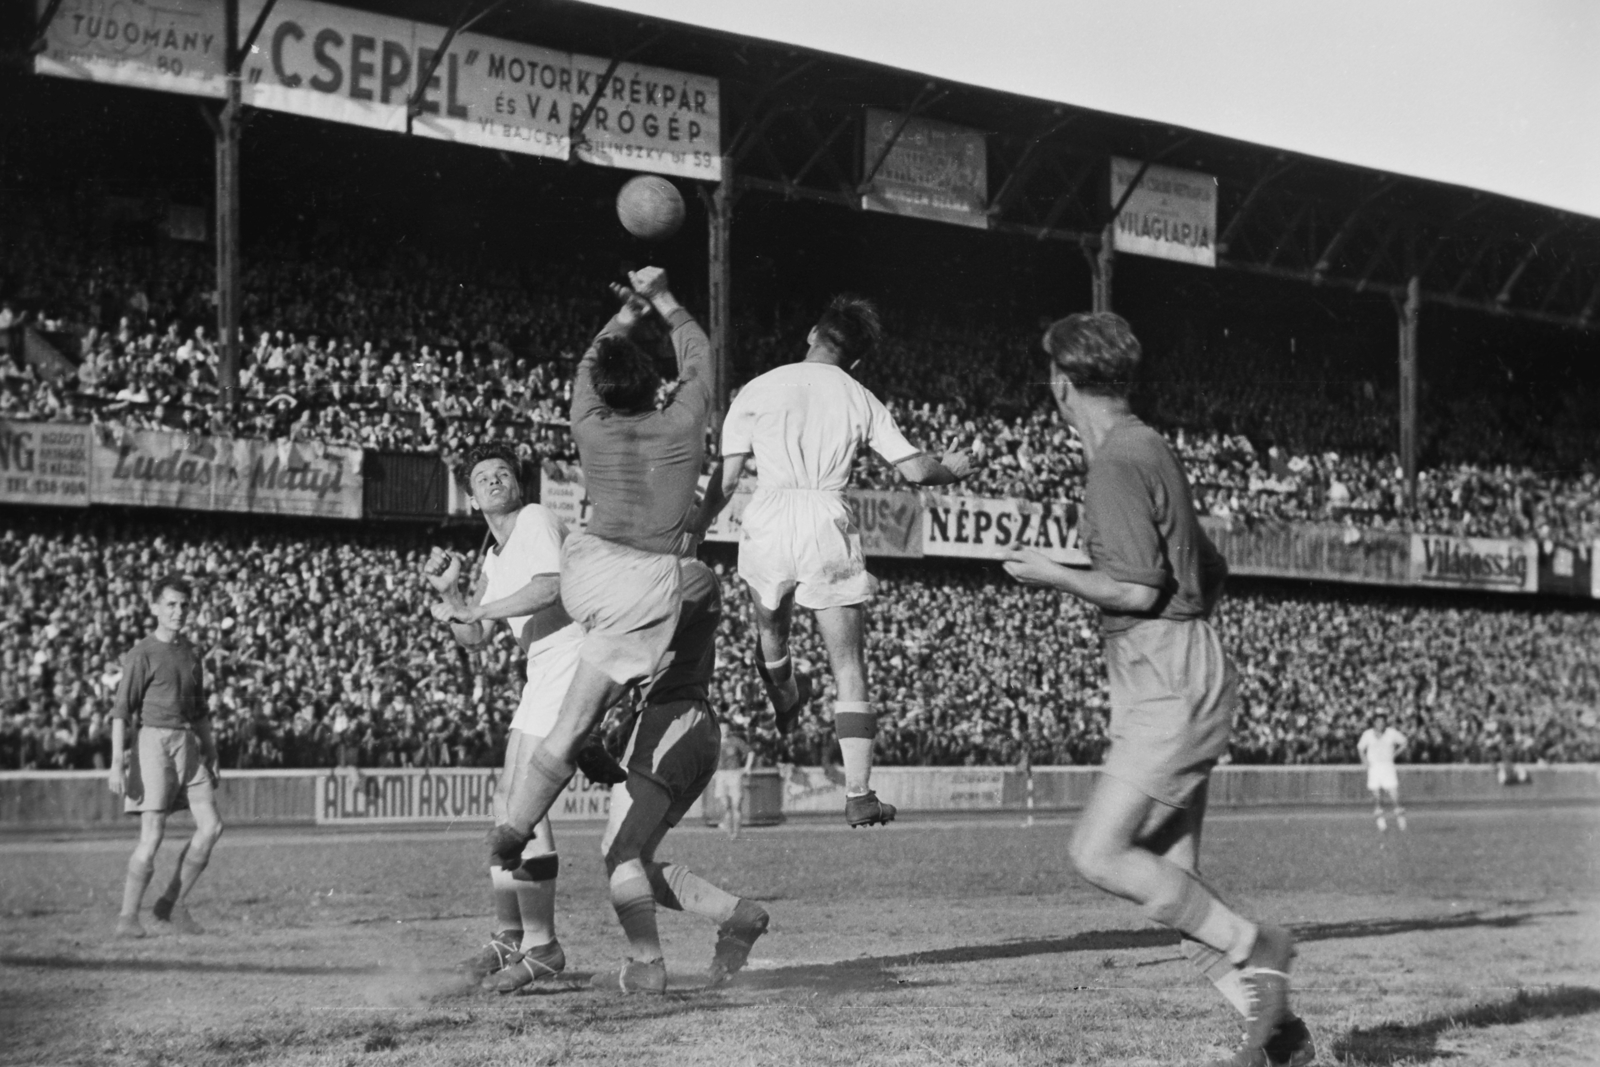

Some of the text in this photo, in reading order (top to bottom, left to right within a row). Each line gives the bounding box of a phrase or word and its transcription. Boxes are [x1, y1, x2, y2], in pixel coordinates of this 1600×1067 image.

[72, 13, 214, 54] TUDOMÁNY
[495, 91, 516, 115] ÉS
[112, 448, 212, 485] Ludas
[929, 501, 1080, 549] NÉPSZAV
